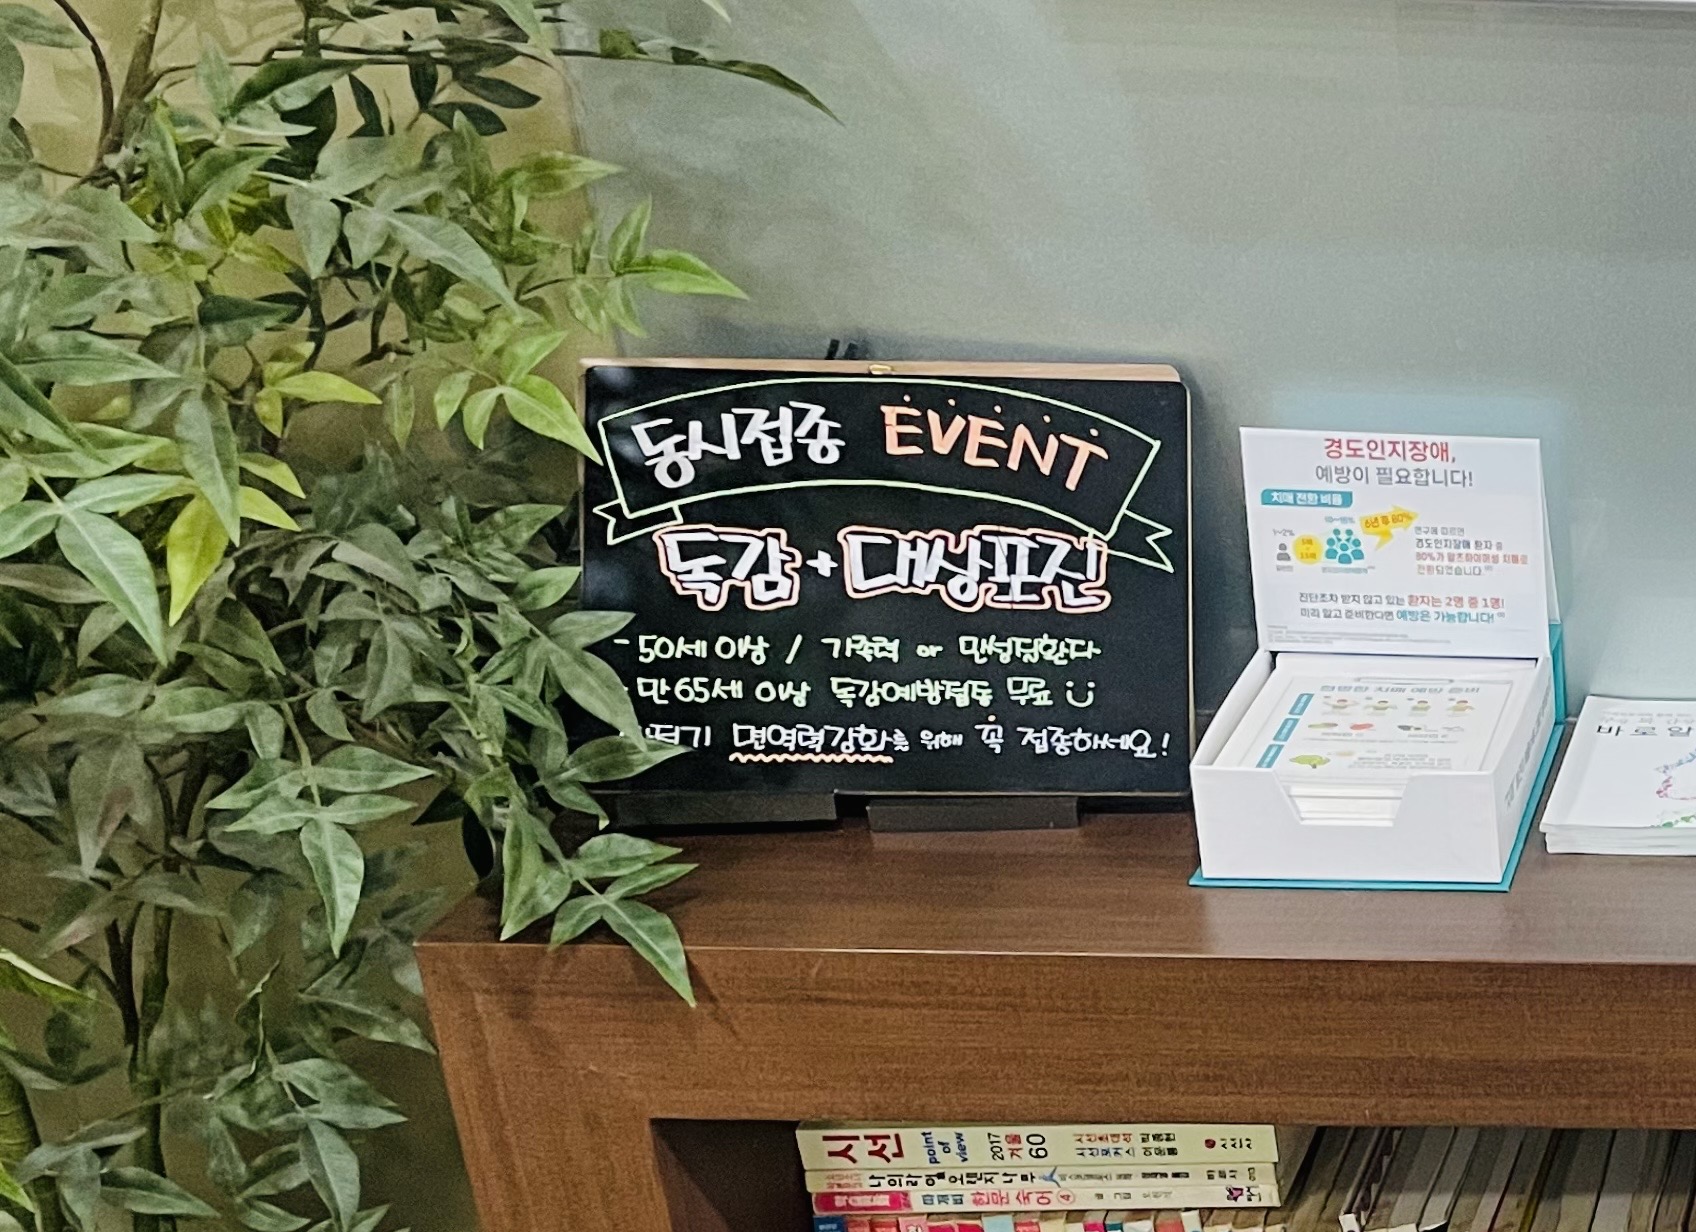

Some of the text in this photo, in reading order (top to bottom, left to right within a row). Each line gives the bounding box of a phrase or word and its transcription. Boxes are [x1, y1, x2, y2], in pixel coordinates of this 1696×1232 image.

[631, 402, 1108, 491] 동시접종 EVENT
[1324, 438, 1456, 463] 경도인지장애,
[1315, 465, 1473, 487] 예방이 필요합니다!
[660, 529, 1108, 608] 독감 대상포진
[639, 635, 707, 663] 50세
[715, 635, 769, 665] 이상
[916, 645, 943, 658] or
[755, 681, 811, 707] 이상
[1007, 676, 1053, 706] 무료
[920, 730, 963, 749] 위해
[975, 724, 1003, 754] 꼭
[1596, 725, 1659, 737] 바로
[822, 1133, 904, 1164] 시선
[922, 1131, 941, 1165] point
[938, 1140, 951, 1154] of
[954, 1131, 968, 1163] view
[989, 1132, 1005, 1161] 2017
[1026, 1132, 1049, 1160] 60
